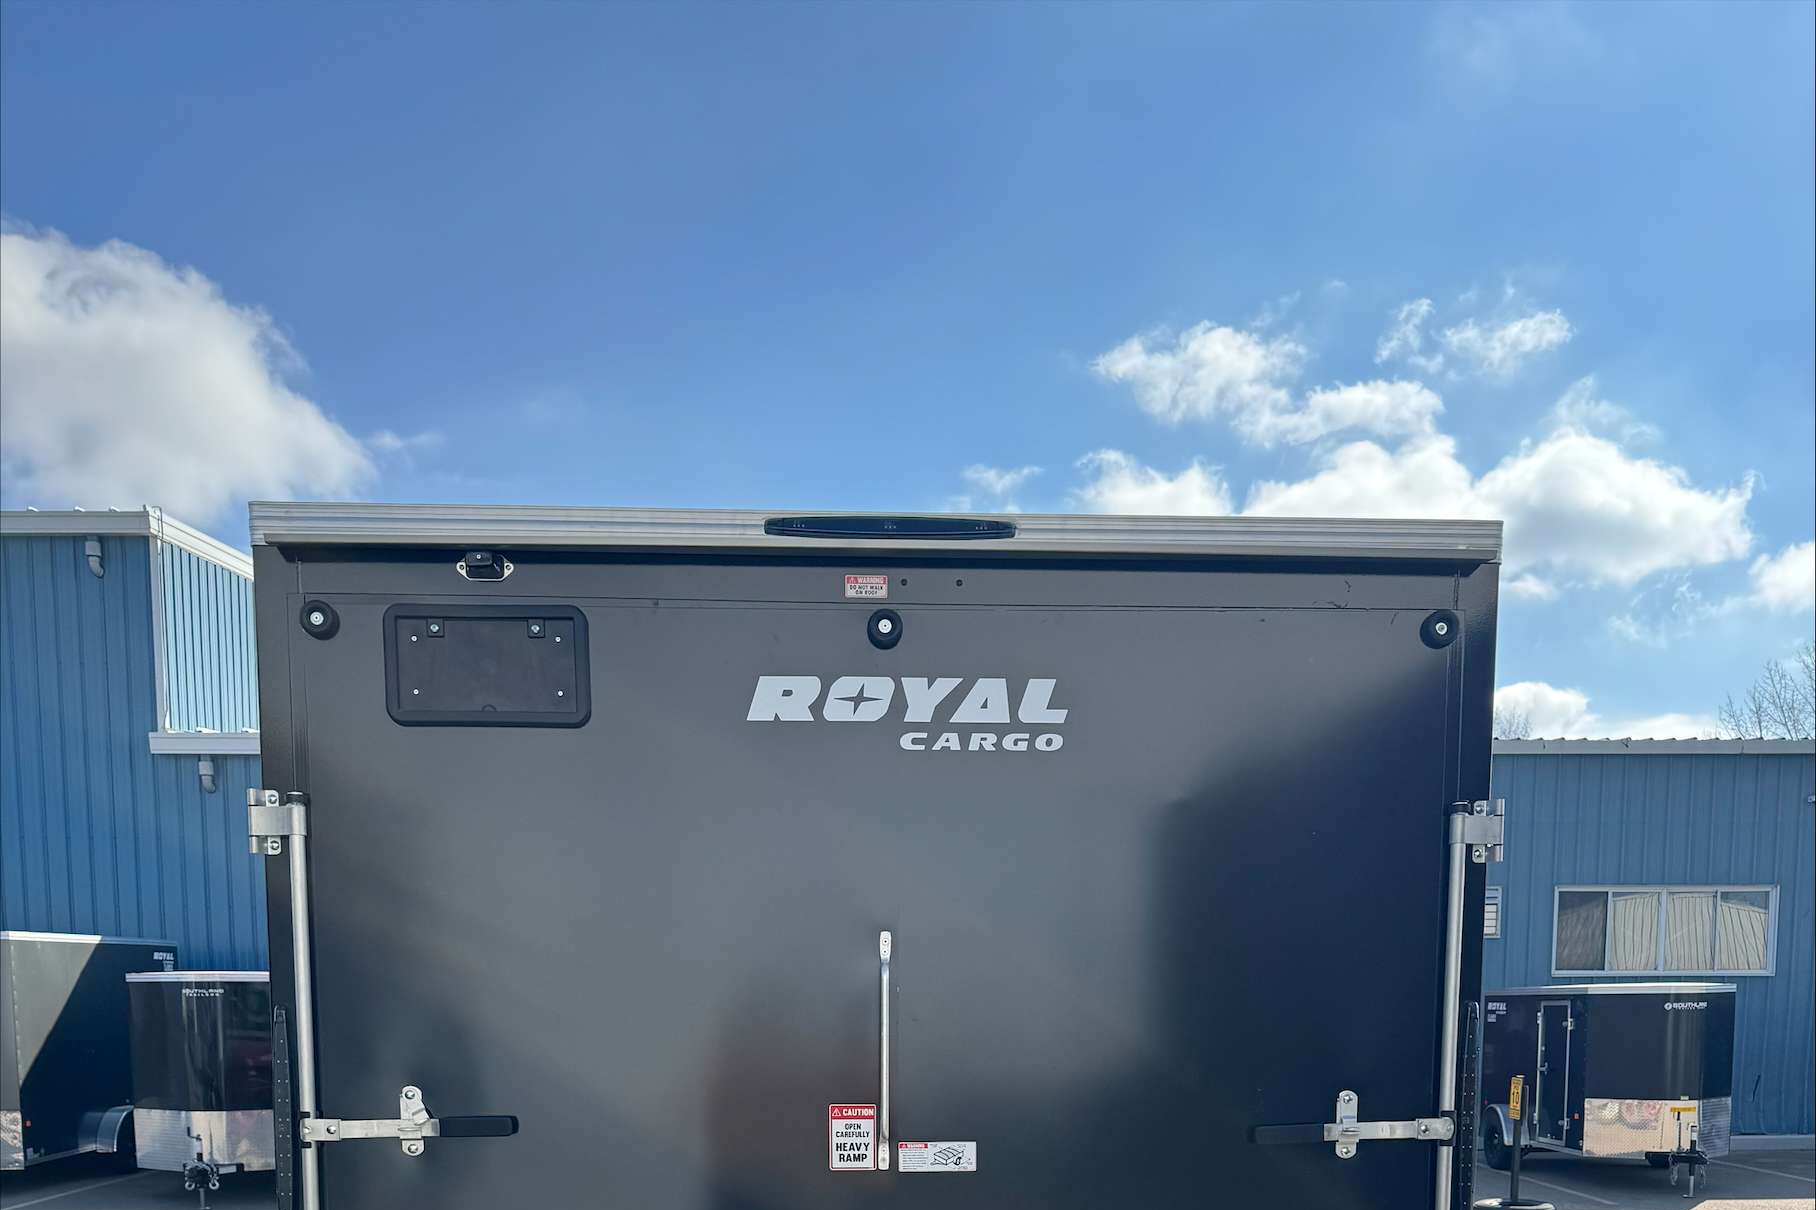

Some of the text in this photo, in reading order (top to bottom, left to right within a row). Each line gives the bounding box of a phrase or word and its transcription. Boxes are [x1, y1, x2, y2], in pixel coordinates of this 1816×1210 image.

[746, 675, 1069, 724] ROYAL
[899, 732, 1064, 751] CARGO
[842, 1108, 874, 1117] CAUTION
[844, 1123, 862, 1131] OPEN
[835, 1142, 870, 1151] HEAVY
[839, 1153, 868, 1162] RAMP
